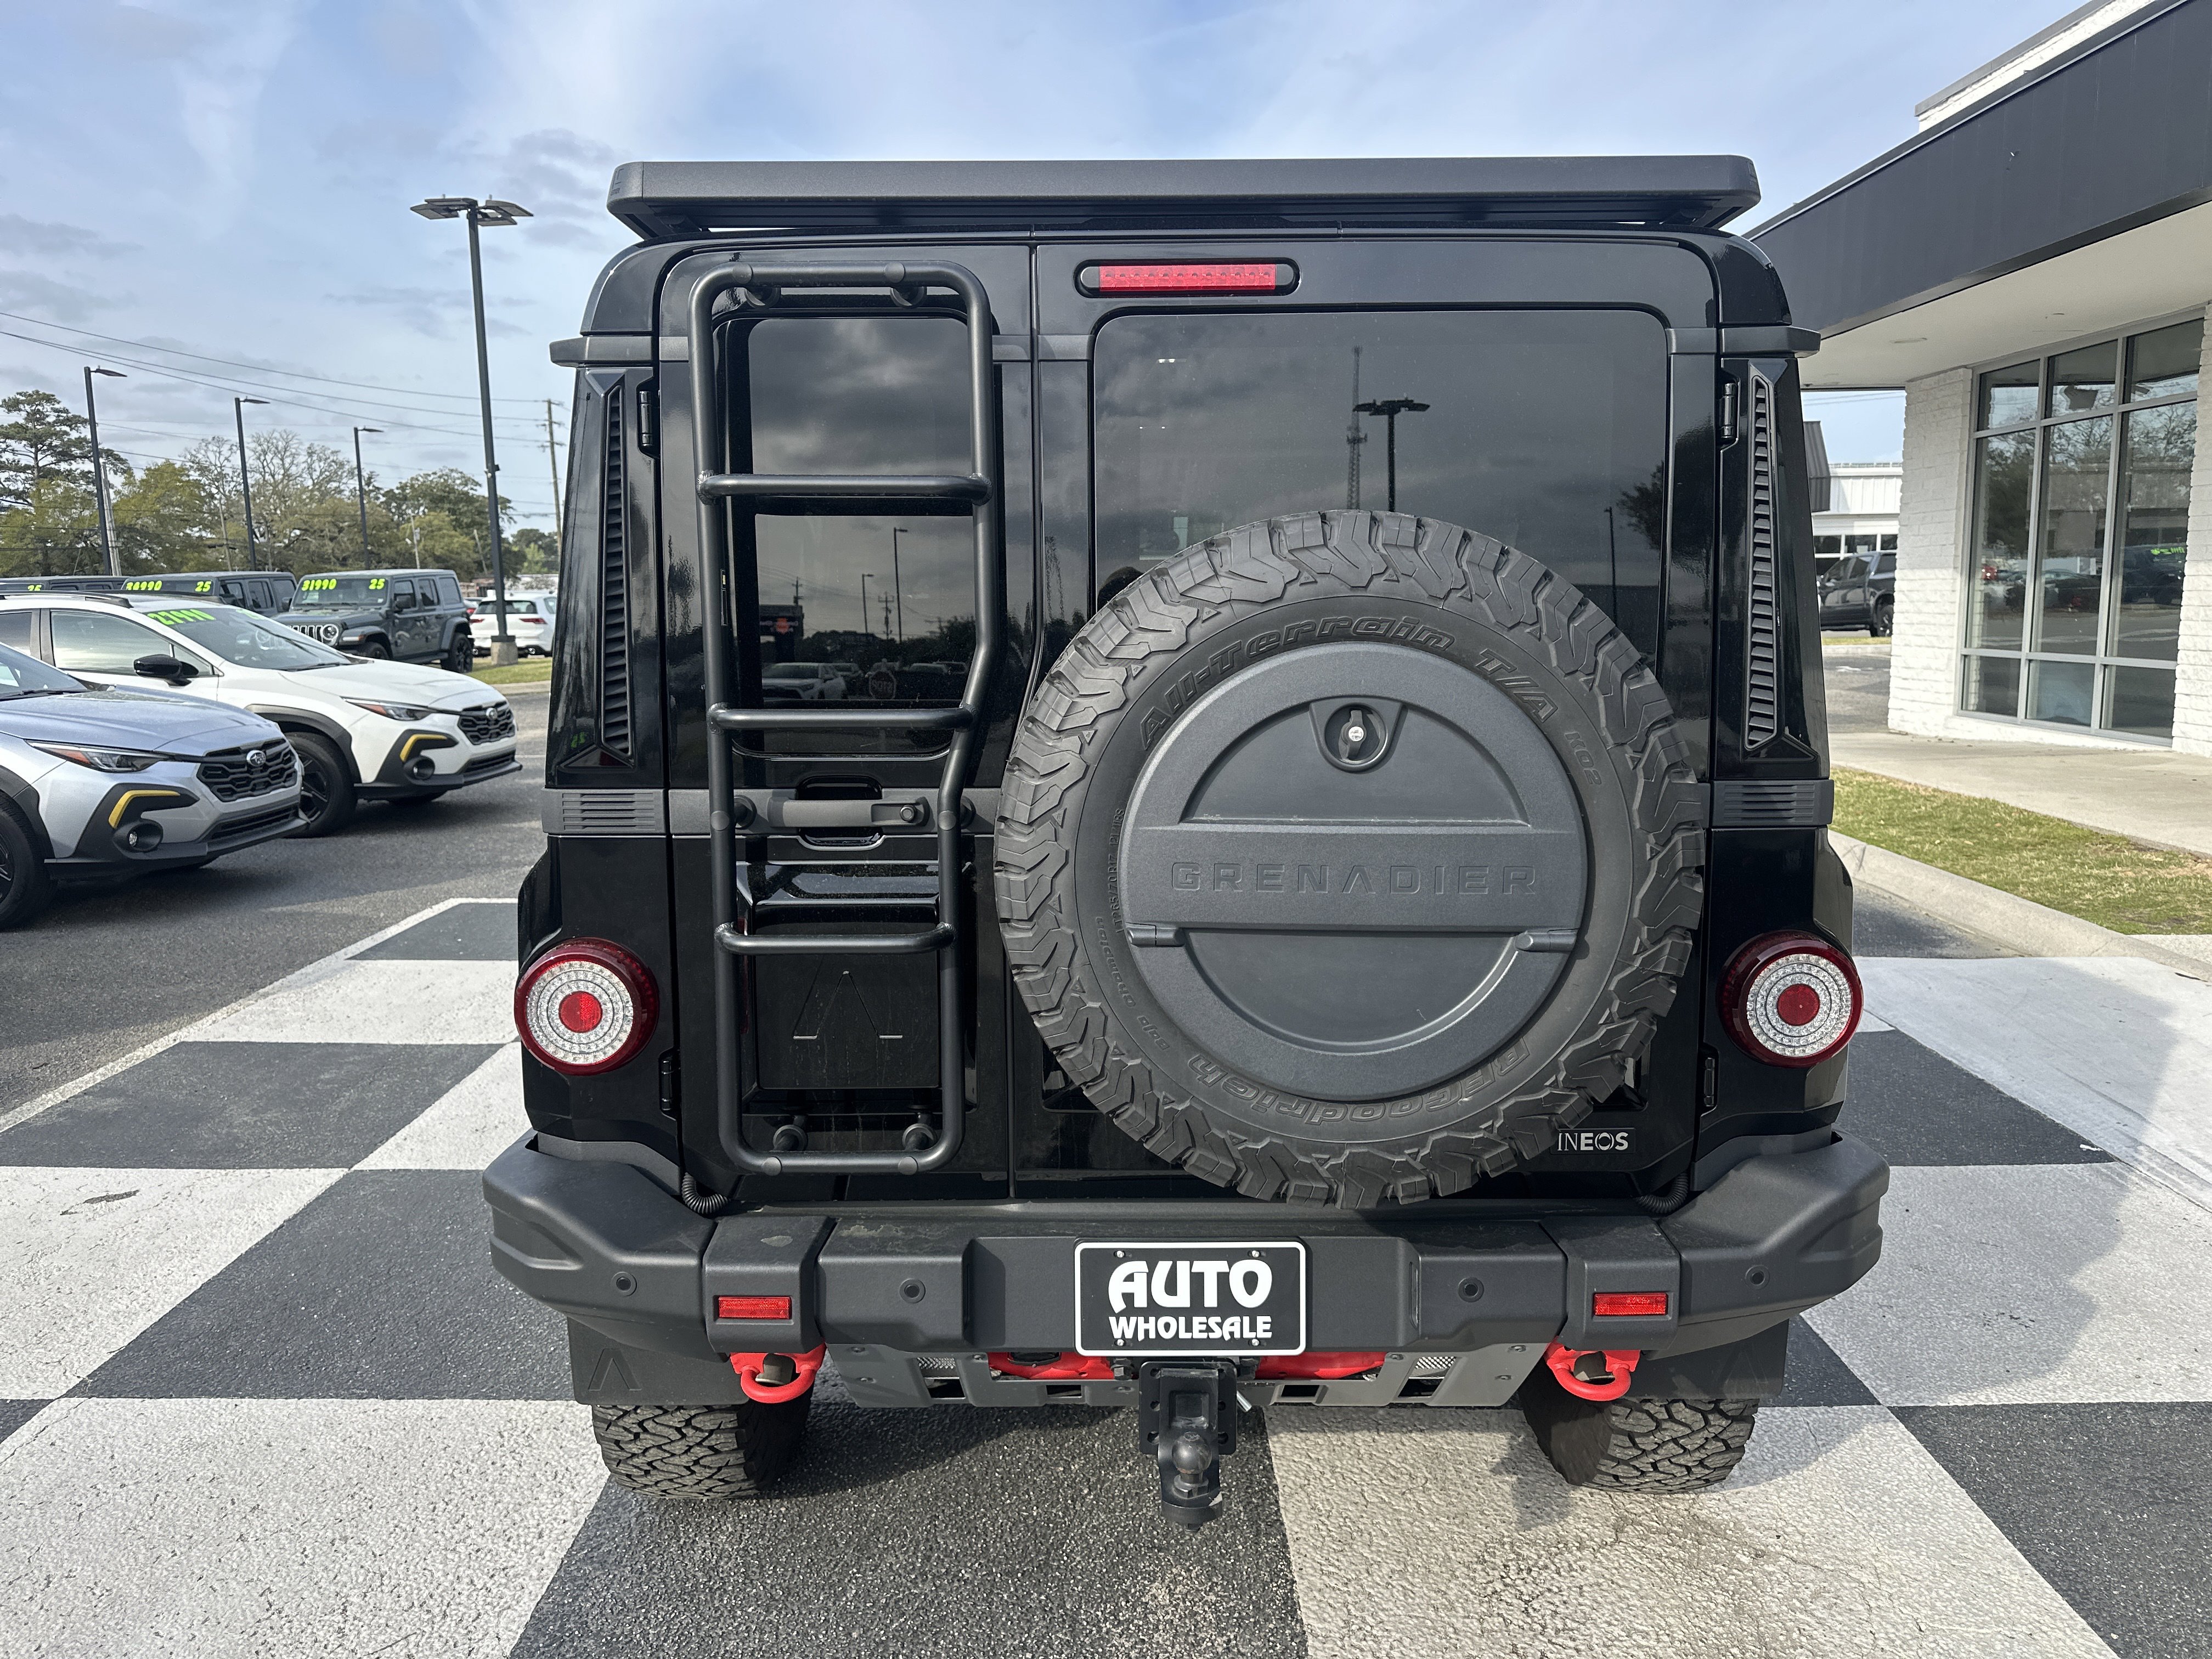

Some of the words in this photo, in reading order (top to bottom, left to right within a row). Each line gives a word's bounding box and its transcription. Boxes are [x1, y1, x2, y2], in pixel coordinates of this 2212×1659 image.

[195, 581, 212, 592] 25
[302, 579, 337, 591] 31990
[369, 579, 385, 590] 25
[147, 609, 216, 625] 27990
[1140, 616, 1455, 751] All-Terrain
[1475, 648, 1559, 723] T/A
[1564, 731, 1602, 785] KO2
[1171, 862, 1536, 895] GRENADIER
[1095, 916, 1136, 1008] Champion
[1137, 1015, 1170, 1051] Baja
[1188, 1037, 1531, 1126] BFGoodrich
[1557, 1132, 1629, 1151] INEOS
[1108, 1259, 1272, 1314] AUTO
[1108, 1316, 1272, 1341] WHOLESALE
